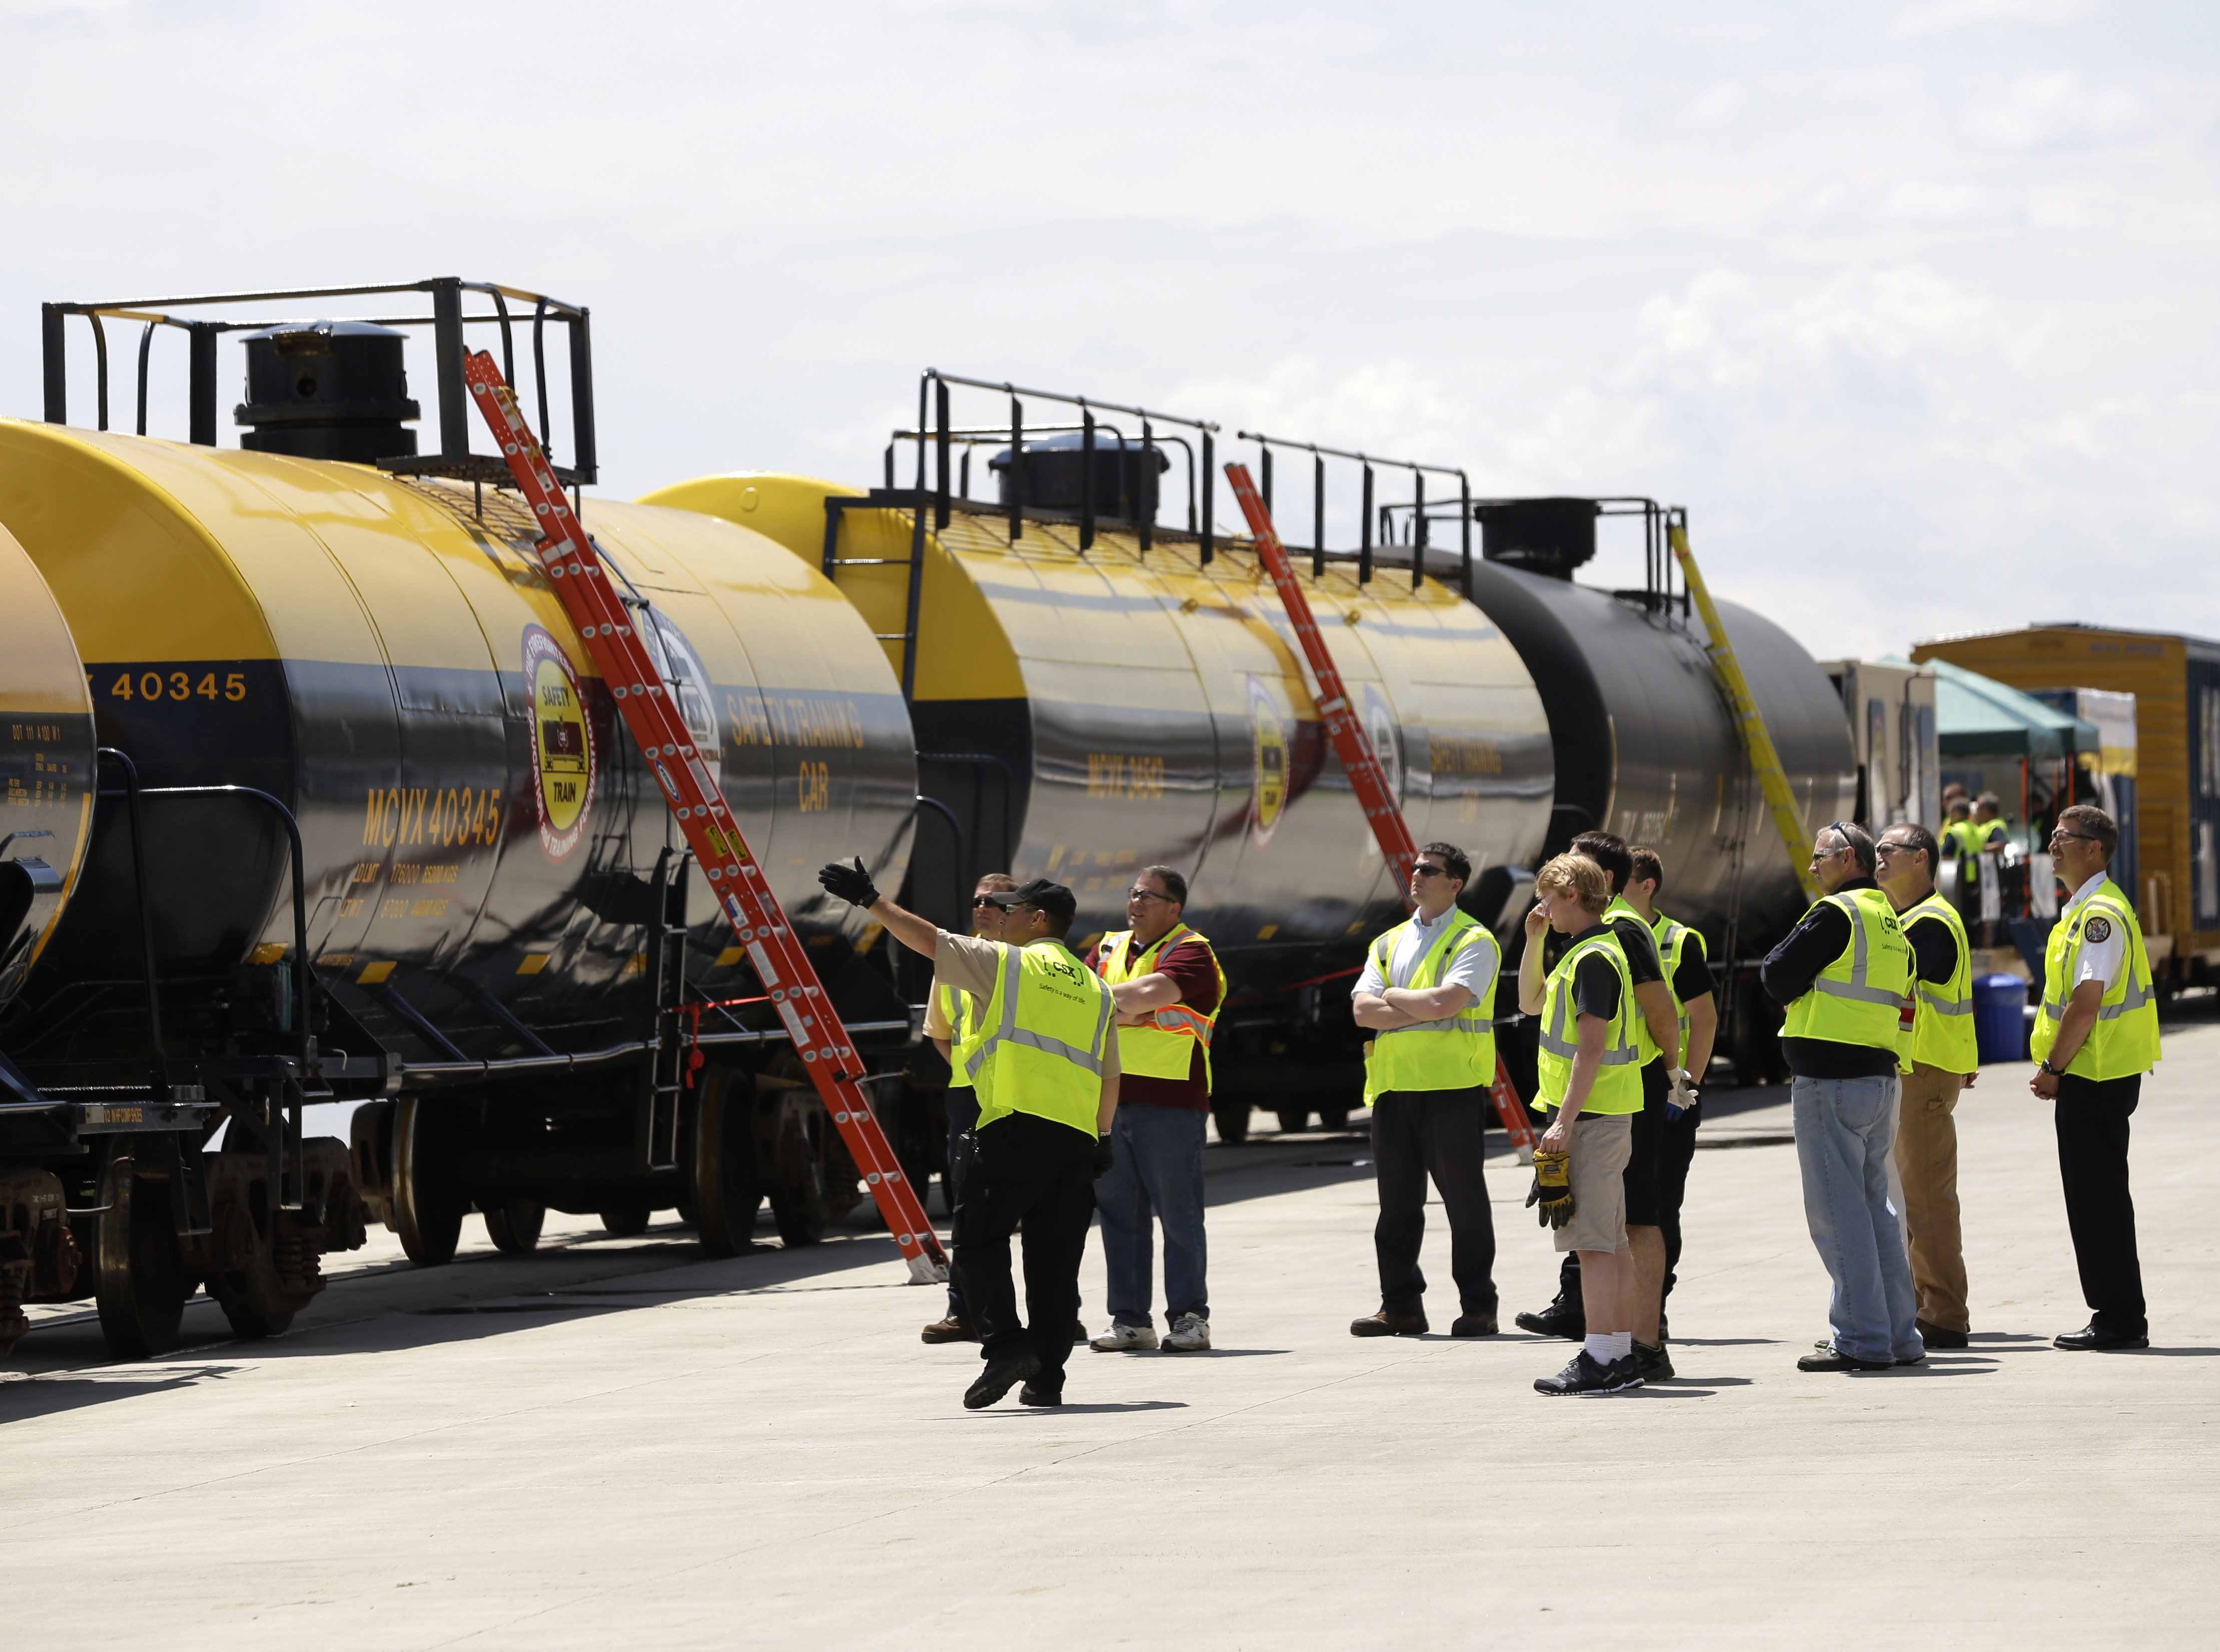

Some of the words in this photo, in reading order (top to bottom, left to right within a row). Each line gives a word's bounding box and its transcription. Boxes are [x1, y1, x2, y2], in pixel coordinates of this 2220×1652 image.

[112, 672, 245, 701] 40345
[542, 685, 570, 707] SAFETY
[13, 724, 23, 740] DOT
[726, 692, 790, 746] SAFETY
[786, 697, 864, 748] TRAINING
[527, 705, 545, 822] EDUCATION
[579, 707, 597, 832] FOUNDATION
[553, 781, 576, 803] TRAIN
[799, 761, 829, 812] CAR
[362, 787, 428, 848] MCVX
[428, 786, 500, 848] 40345
[1039, 983, 1054, 994] Safety
